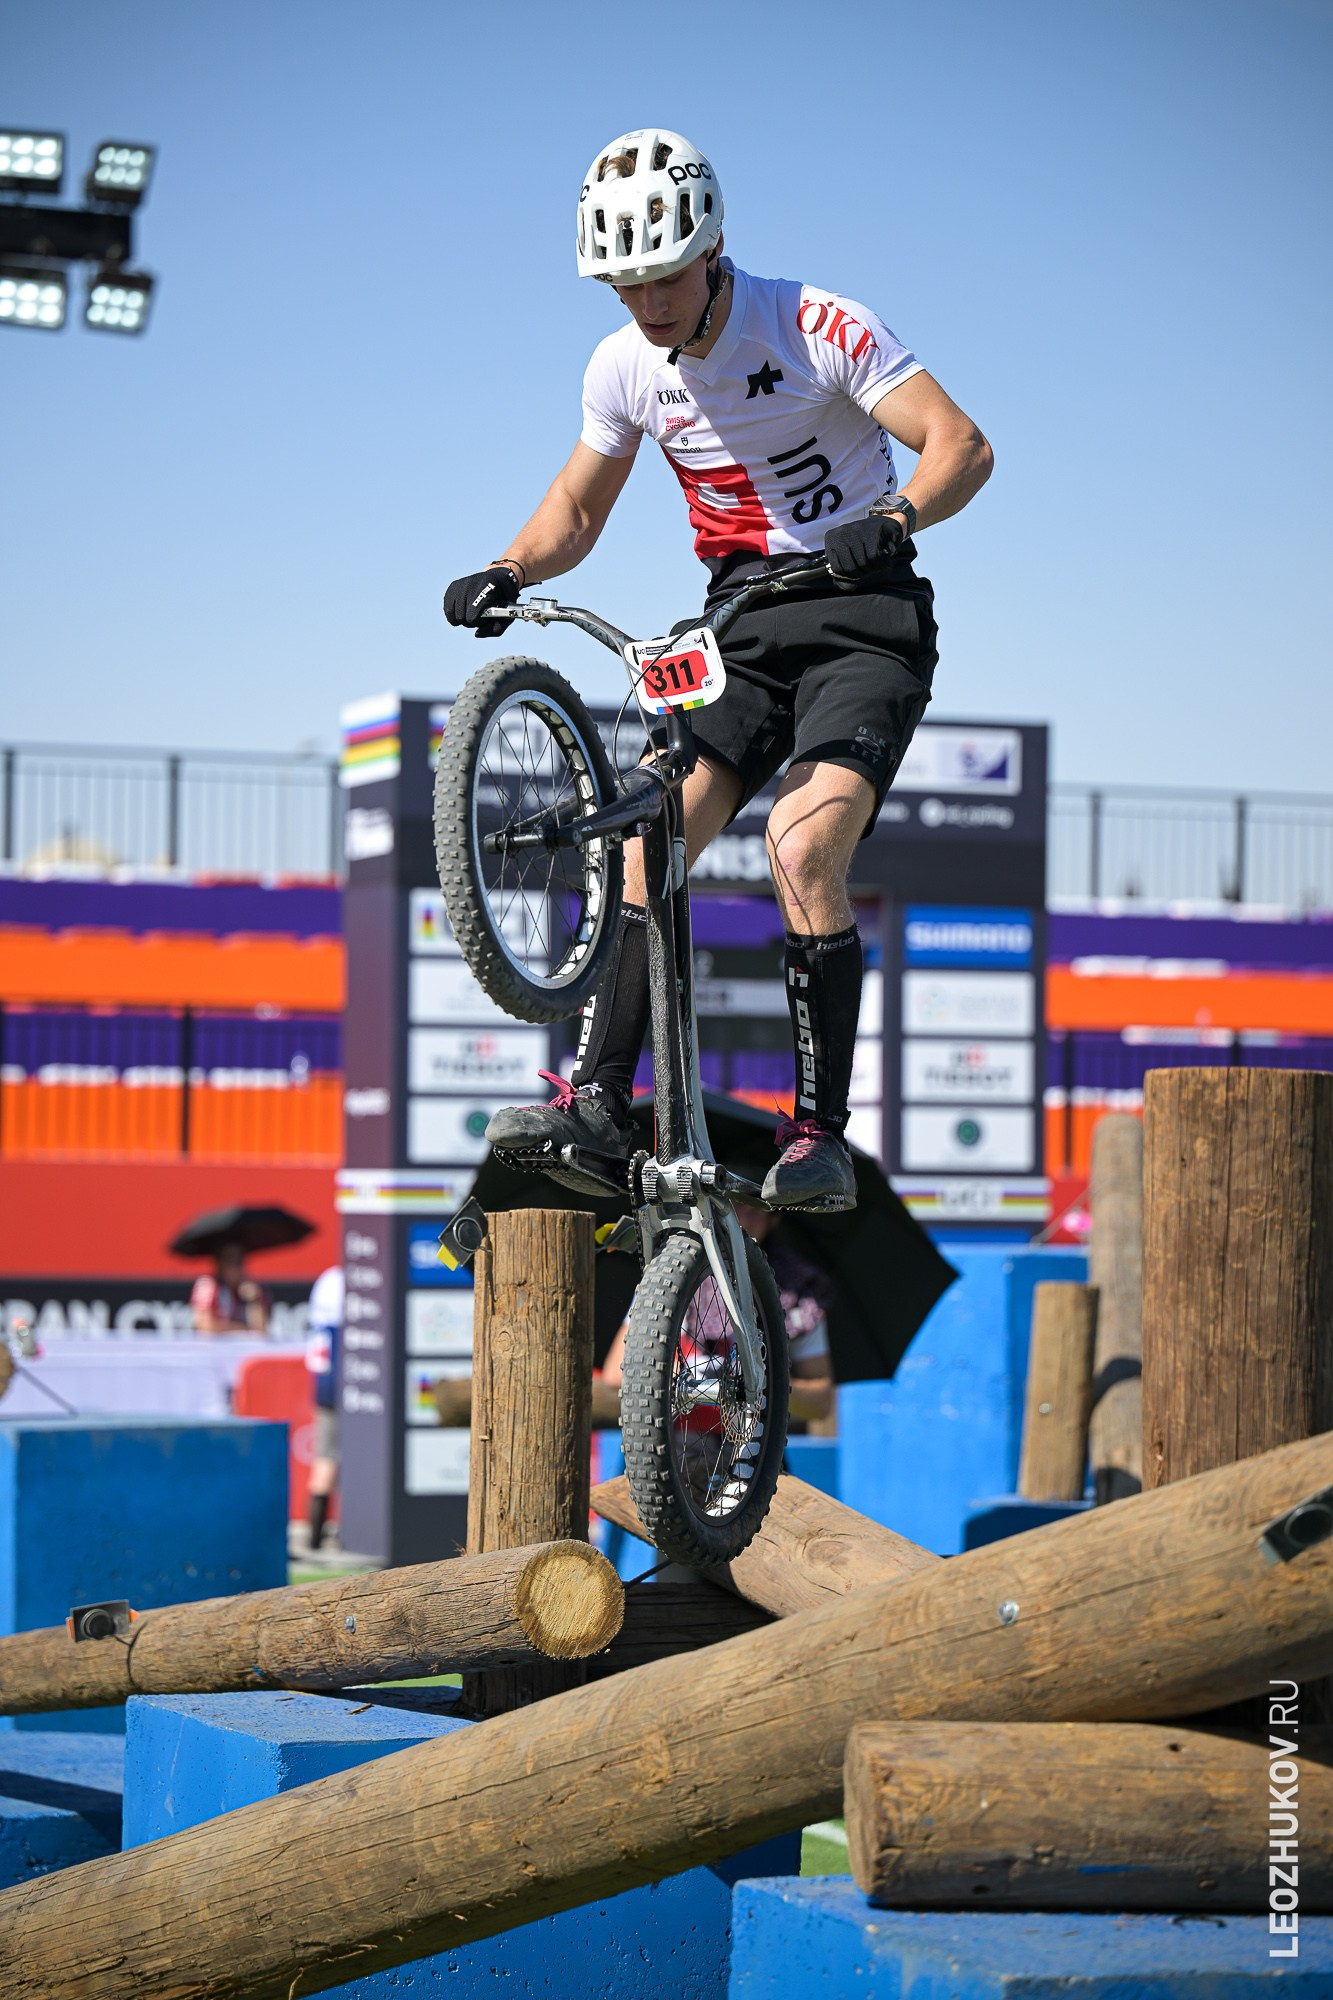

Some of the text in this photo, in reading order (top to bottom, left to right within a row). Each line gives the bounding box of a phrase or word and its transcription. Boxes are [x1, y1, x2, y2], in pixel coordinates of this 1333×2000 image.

[656, 388, 690, 406] ÖKK
[665, 416, 685, 425] SWISS
[665, 420, 696, 431] CYCLING
[767, 436, 843, 524] SUI
[650, 658, 695, 692] 311
[816, 935, 855, 951] hebo
[795, 998, 817, 1111] hebo
